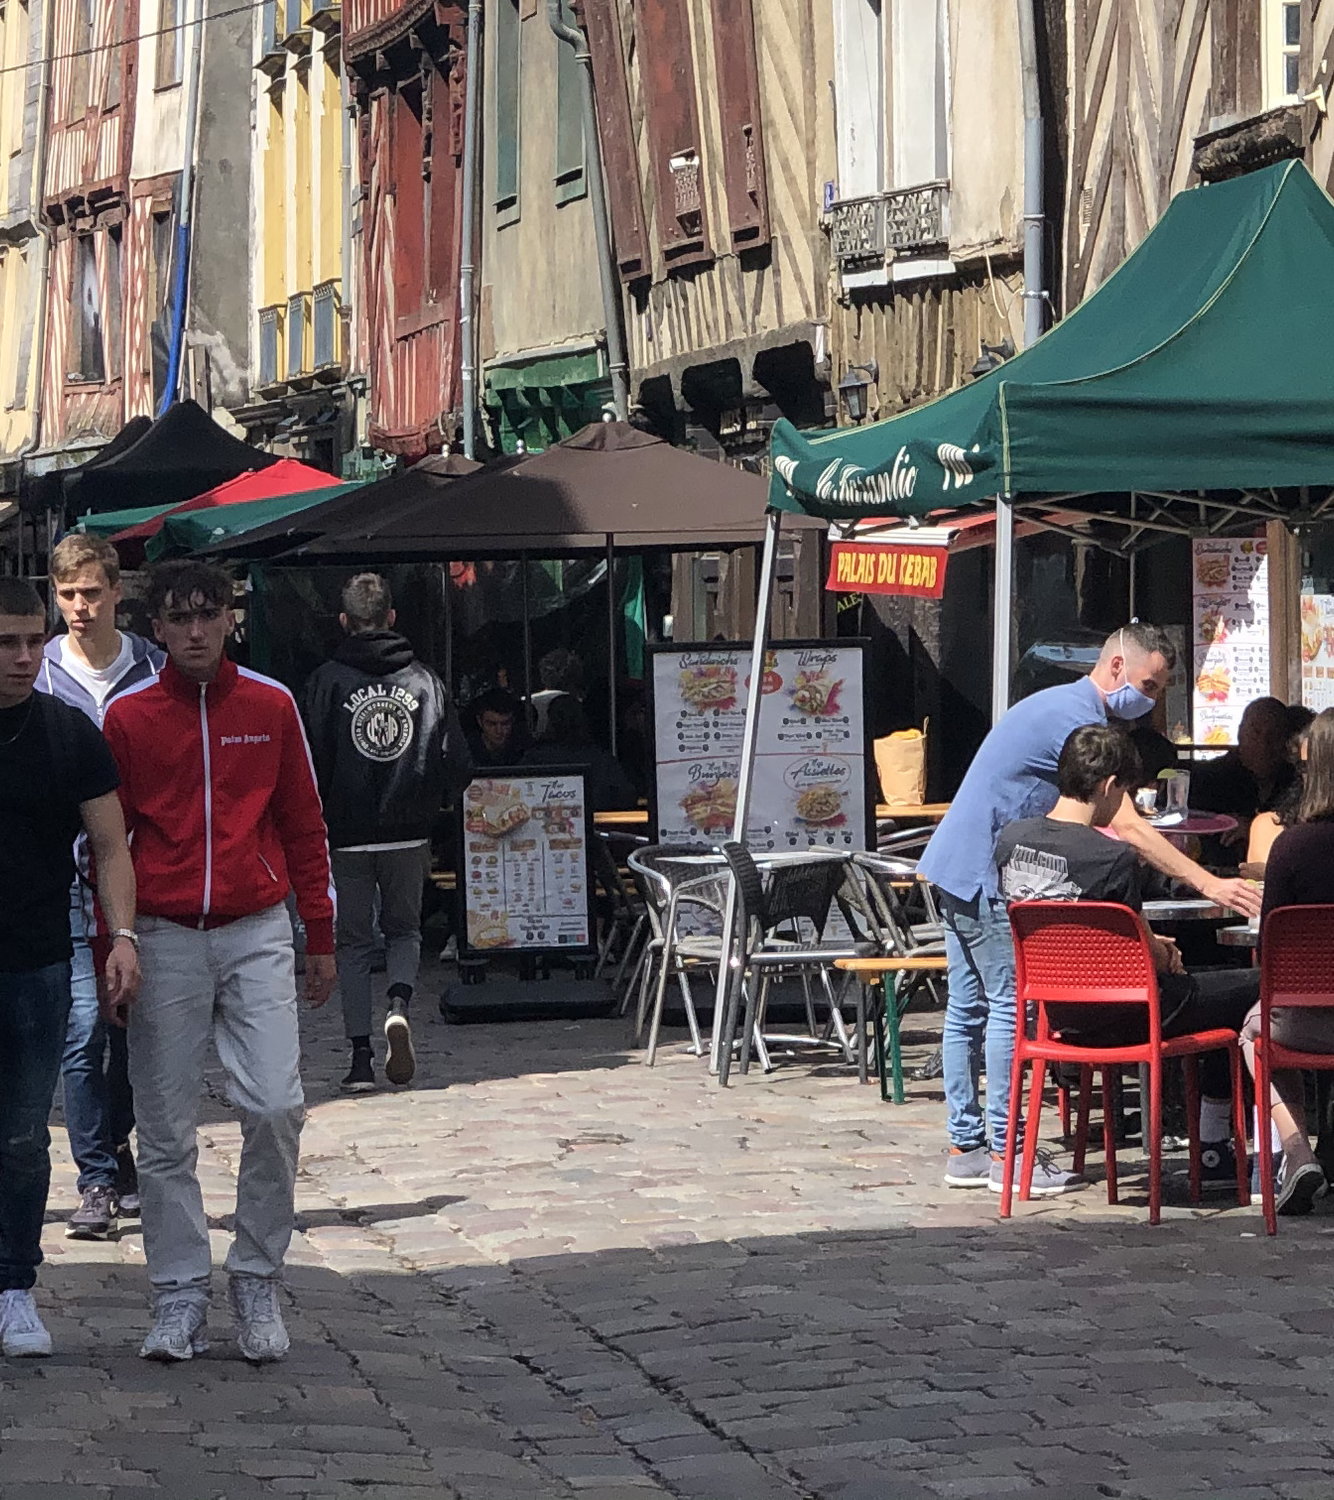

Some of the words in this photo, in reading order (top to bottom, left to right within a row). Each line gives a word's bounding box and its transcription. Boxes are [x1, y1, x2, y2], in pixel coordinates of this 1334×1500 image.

[837, 552, 876, 585] PALAIS
[877, 552, 898, 585] DU
[899, 554, 938, 589] KEBAB
[679, 653, 740, 669] Sandwichs
[343, 684, 387, 713] LOCAL
[390, 685, 420, 712] 1299
[220, 735, 242, 746] Palm
[244, 733, 270, 744] Angels
[688, 763, 740, 786] Burgers
[541, 784, 577, 803] Tacos
